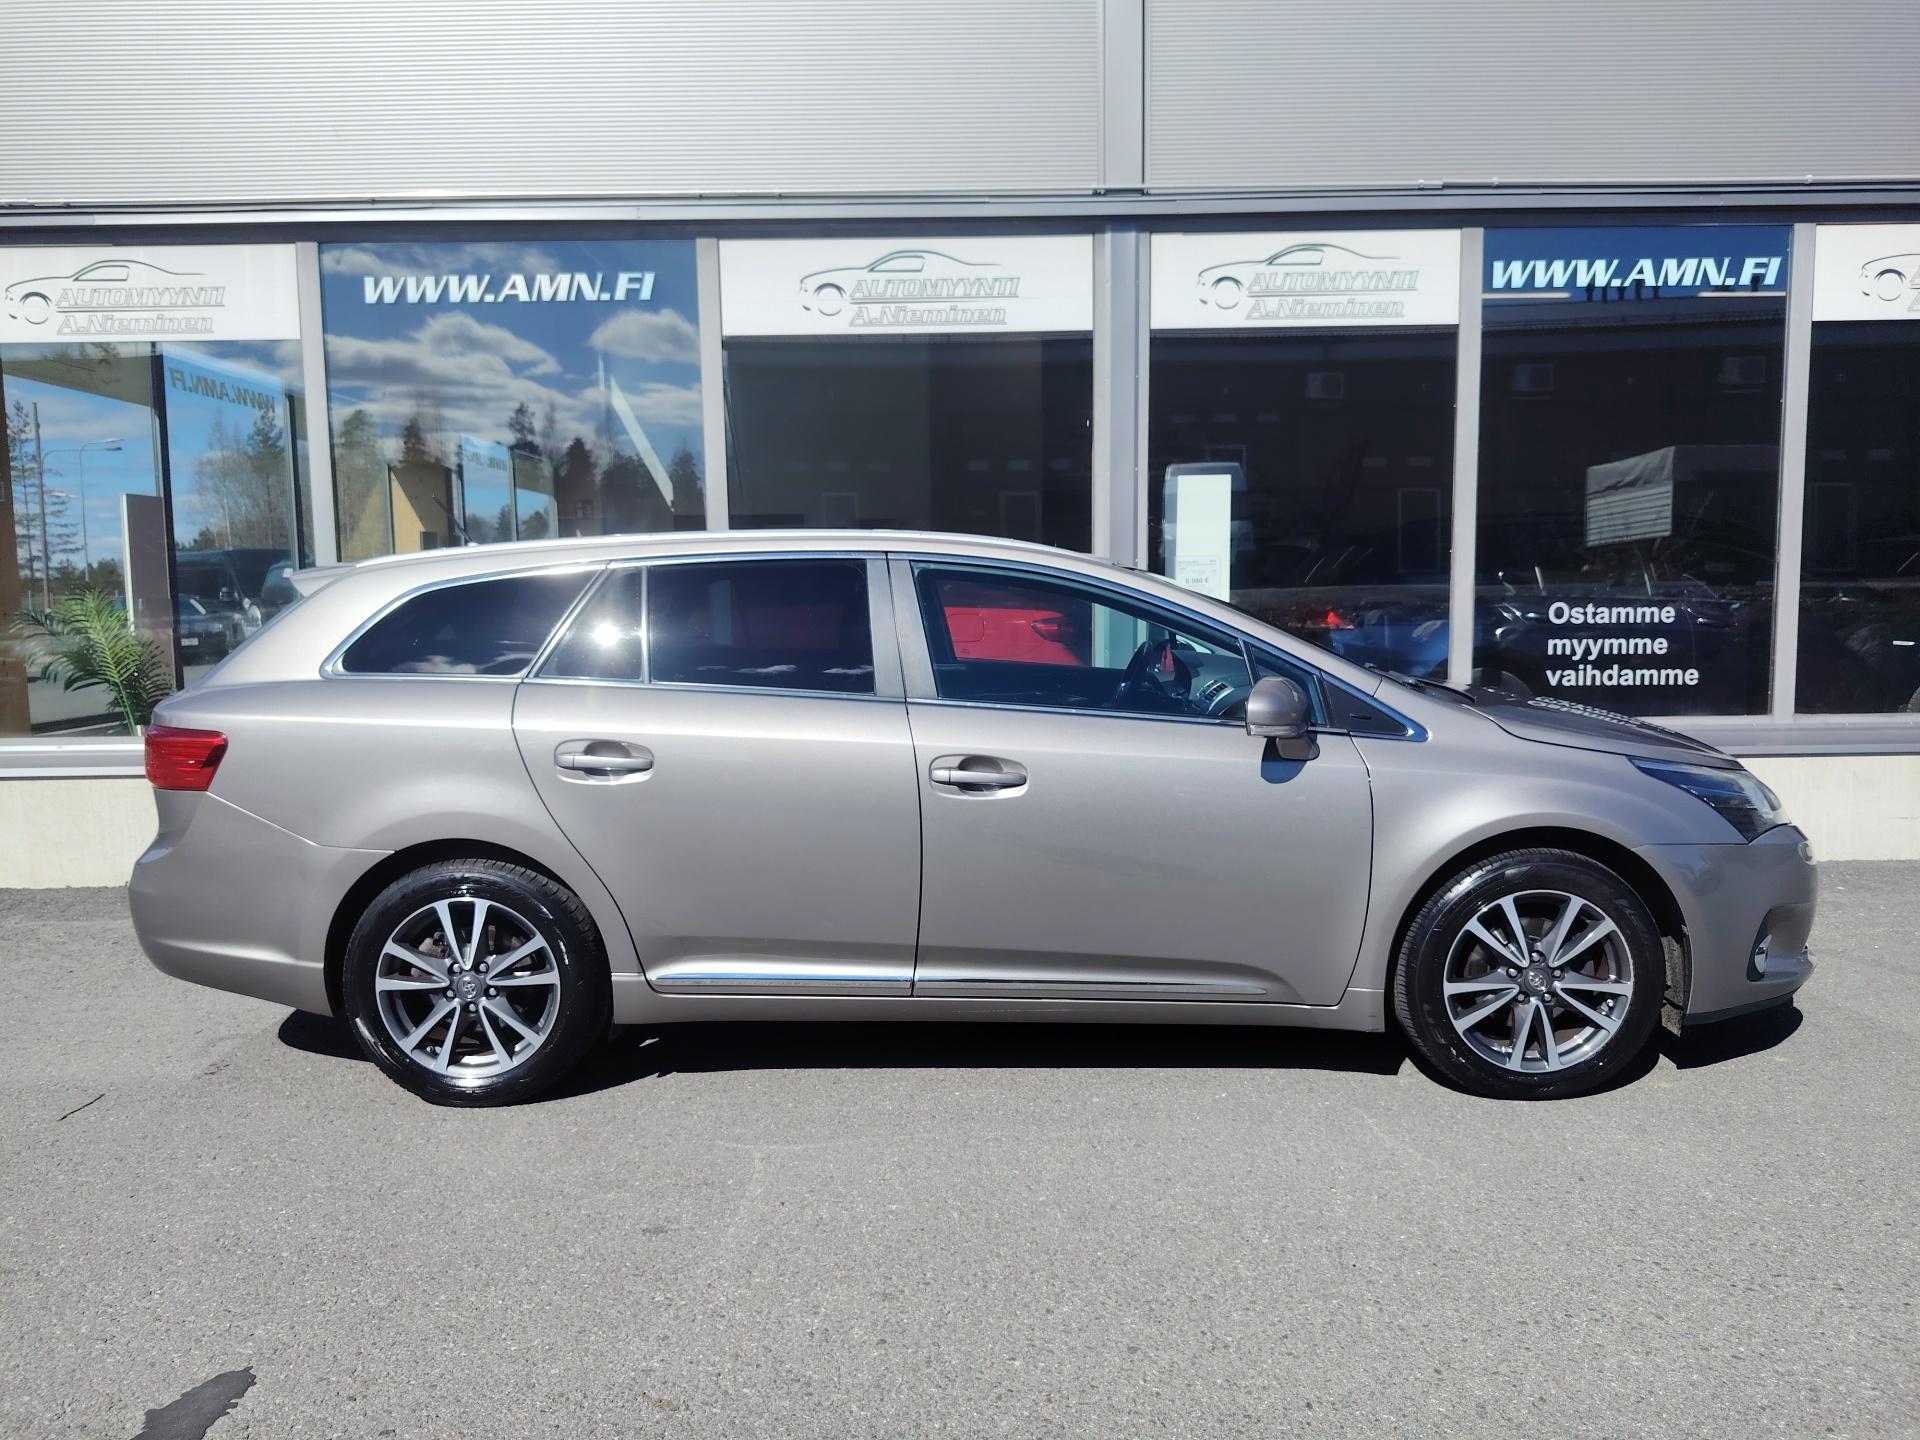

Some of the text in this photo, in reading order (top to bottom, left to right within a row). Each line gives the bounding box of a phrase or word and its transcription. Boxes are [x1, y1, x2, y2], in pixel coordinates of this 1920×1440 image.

[1249, 270, 1419, 291] AUTOMYYNTI
[1492, 256, 1782, 289] WWW.AMN.FI
[56, 286, 226, 306] AUTOMYYNTI
[363, 271, 656, 304] WWW.AMN.FI
[850, 277, 1020, 298] AUTOMYYNTI
[850, 304, 1007, 327] A.Nieminen
[1247, 297, 1404, 320] A.Nieminen
[57, 313, 215, 335] A.Nieminen
[1548, 602, 1675, 624] Ostamme
[1547, 637, 1668, 661] myymme
[1546, 664, 1699, 687] vaihdamme
